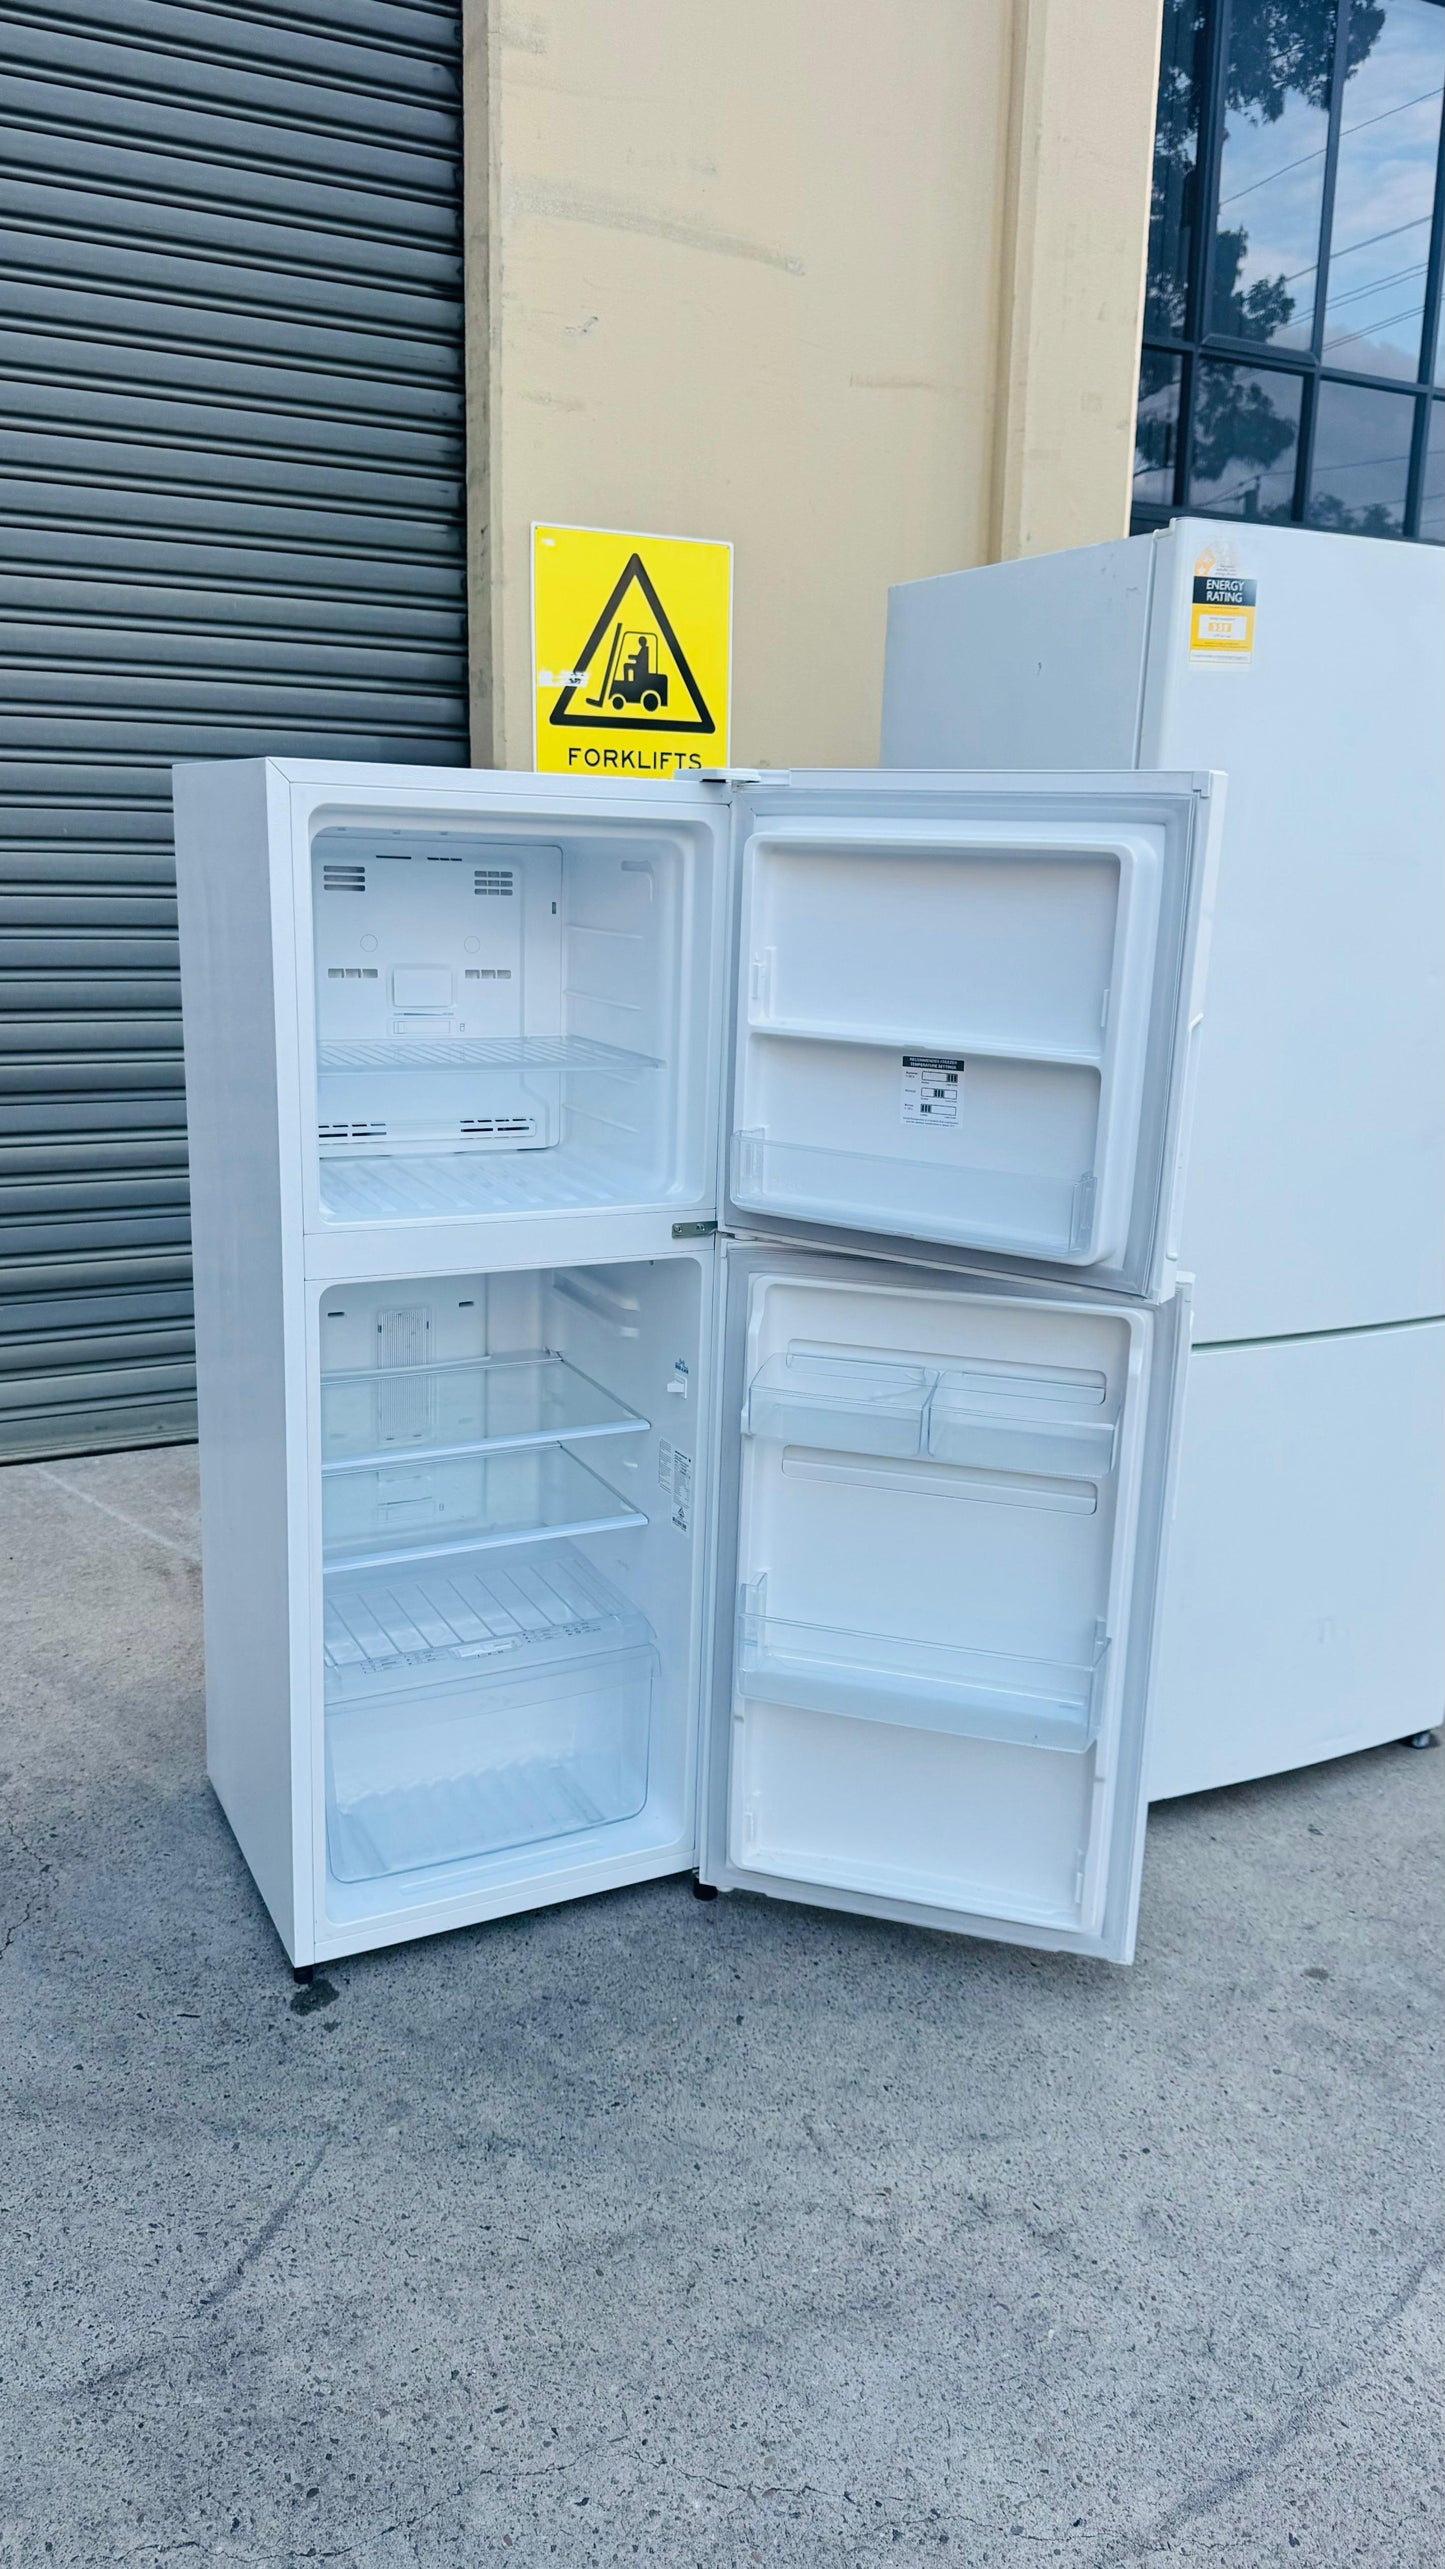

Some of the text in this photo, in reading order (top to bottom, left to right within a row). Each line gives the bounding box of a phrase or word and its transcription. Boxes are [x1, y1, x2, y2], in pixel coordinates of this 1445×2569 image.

[1206, 579, 1245, 592] ENERGY
[1206, 590, 1243, 603] RATING
[568, 747, 702, 770] FORKLIFTS
